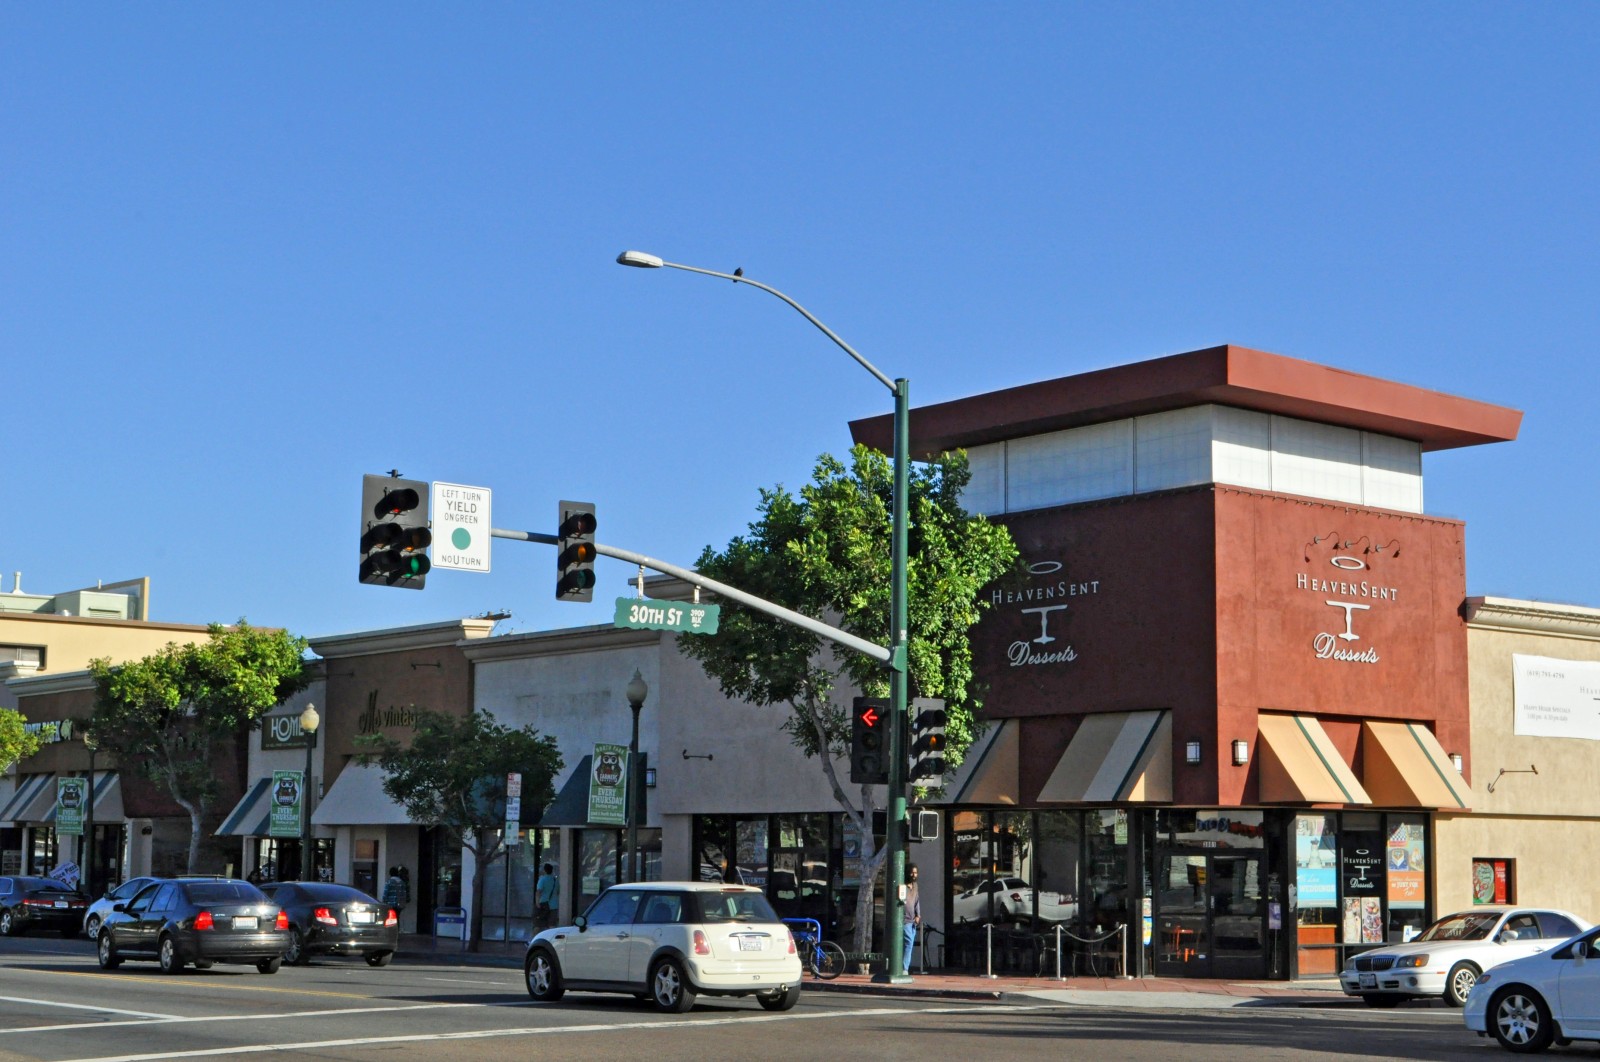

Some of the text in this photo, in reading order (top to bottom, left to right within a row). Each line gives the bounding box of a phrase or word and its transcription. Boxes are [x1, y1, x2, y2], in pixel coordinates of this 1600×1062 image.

[442, 488, 481, 501] LEFT TURN
[446, 500, 477, 514] YIELD
[455, 514, 478, 524] GREEN
[441, 555, 452, 563] NO
[462, 557, 481, 566] TURN
[629, 604, 665, 625] 30TH
[1007, 640, 1078, 667] Desserts
[1313, 632, 1380, 663] Desserts
[597, 788, 617, 796] EVERY
[591, 795, 623, 805] THURSDAY
